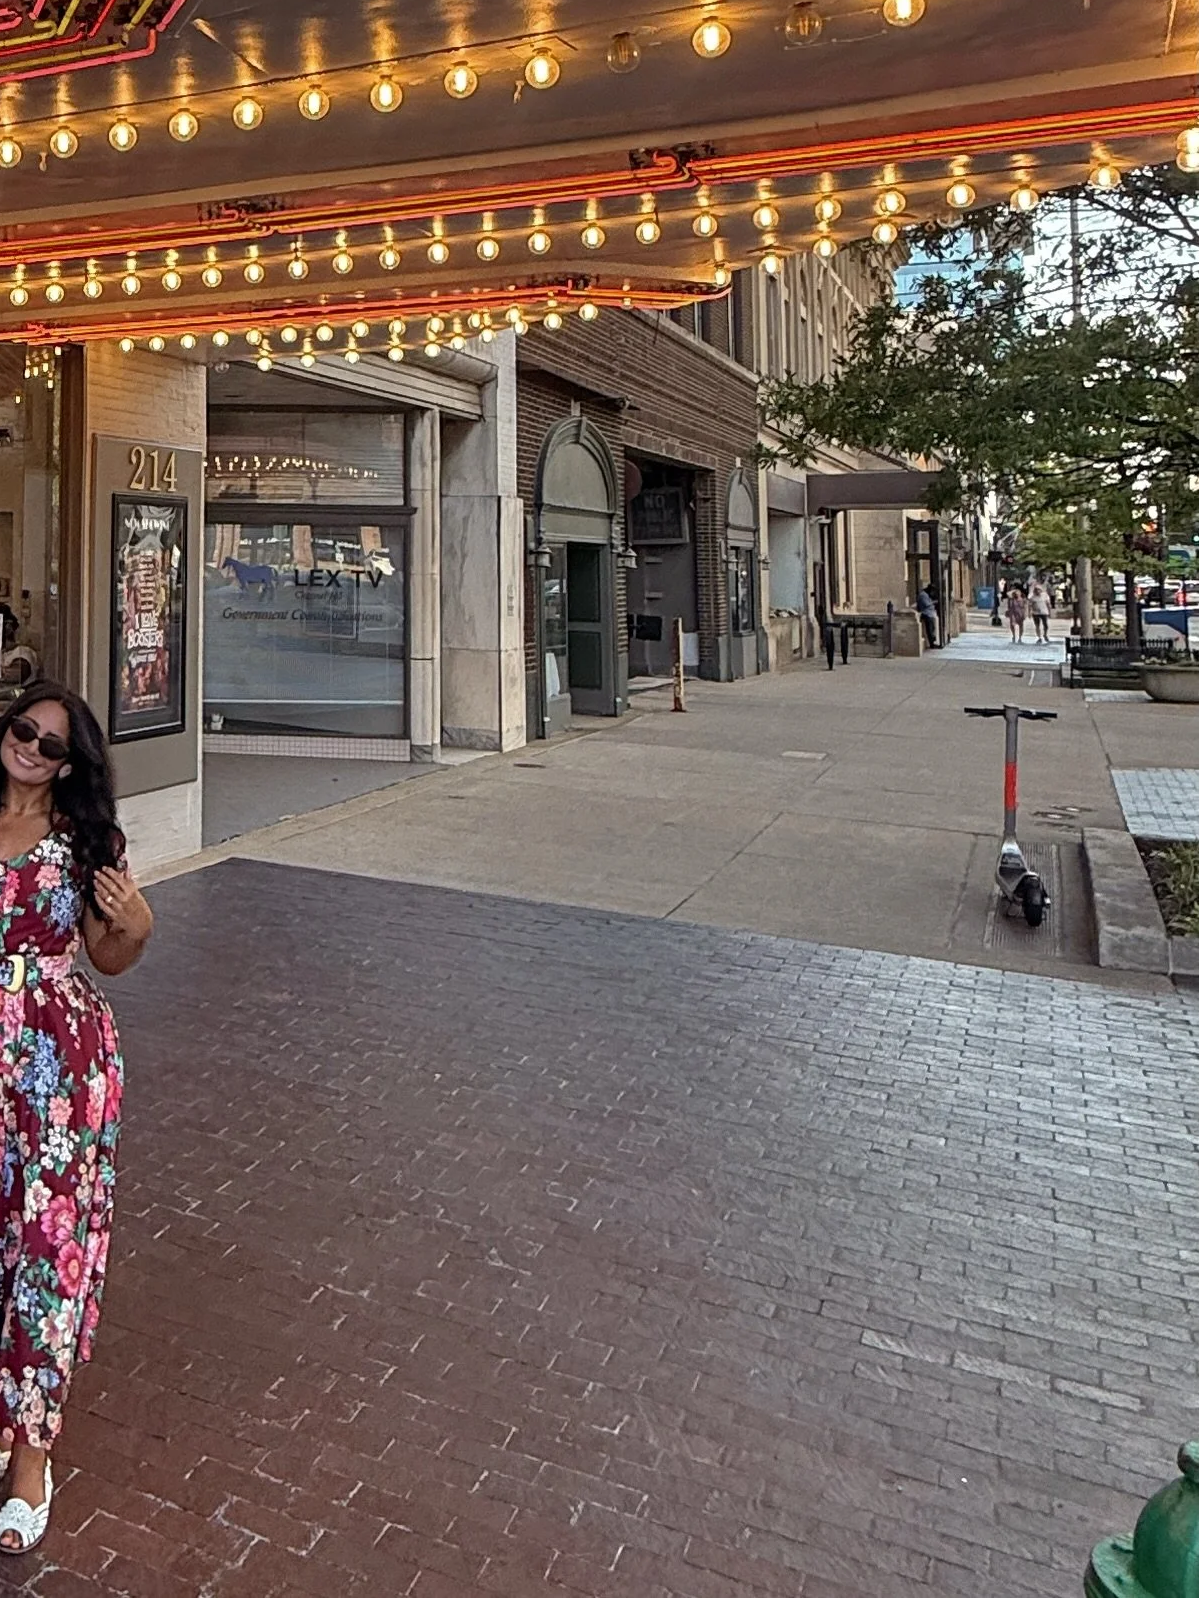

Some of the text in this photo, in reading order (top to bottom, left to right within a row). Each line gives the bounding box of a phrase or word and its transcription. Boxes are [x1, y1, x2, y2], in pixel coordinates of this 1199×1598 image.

[129, 445, 178, 492] 214
[294, 568, 384, 588] LEX TV
[222, 607, 288, 622] Government
